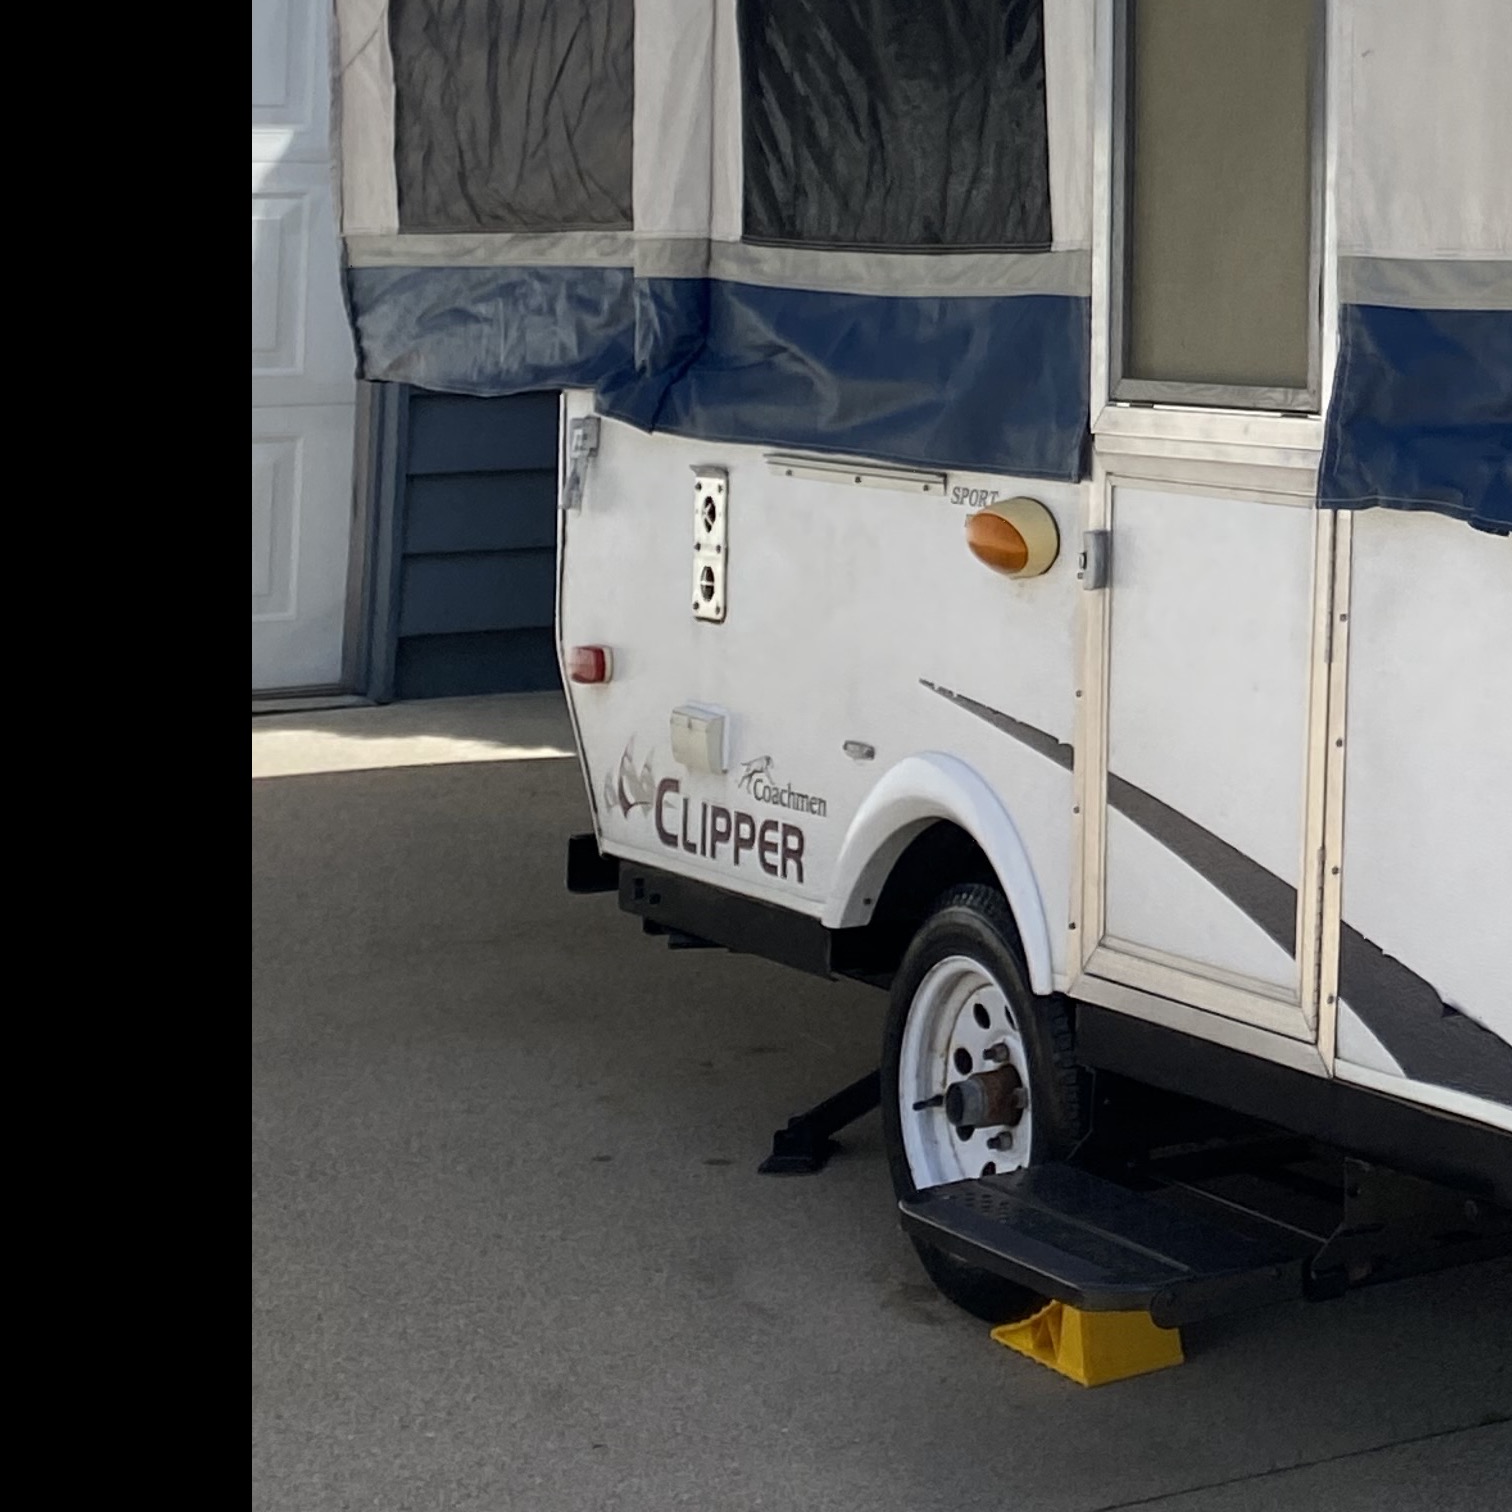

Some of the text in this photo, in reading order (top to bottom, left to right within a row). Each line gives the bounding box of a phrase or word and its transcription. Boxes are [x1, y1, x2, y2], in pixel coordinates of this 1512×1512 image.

[950, 486, 1000, 507] SPORT
[752, 778, 827, 817] Coachmen
[654, 777, 805, 884] CLIPPER
